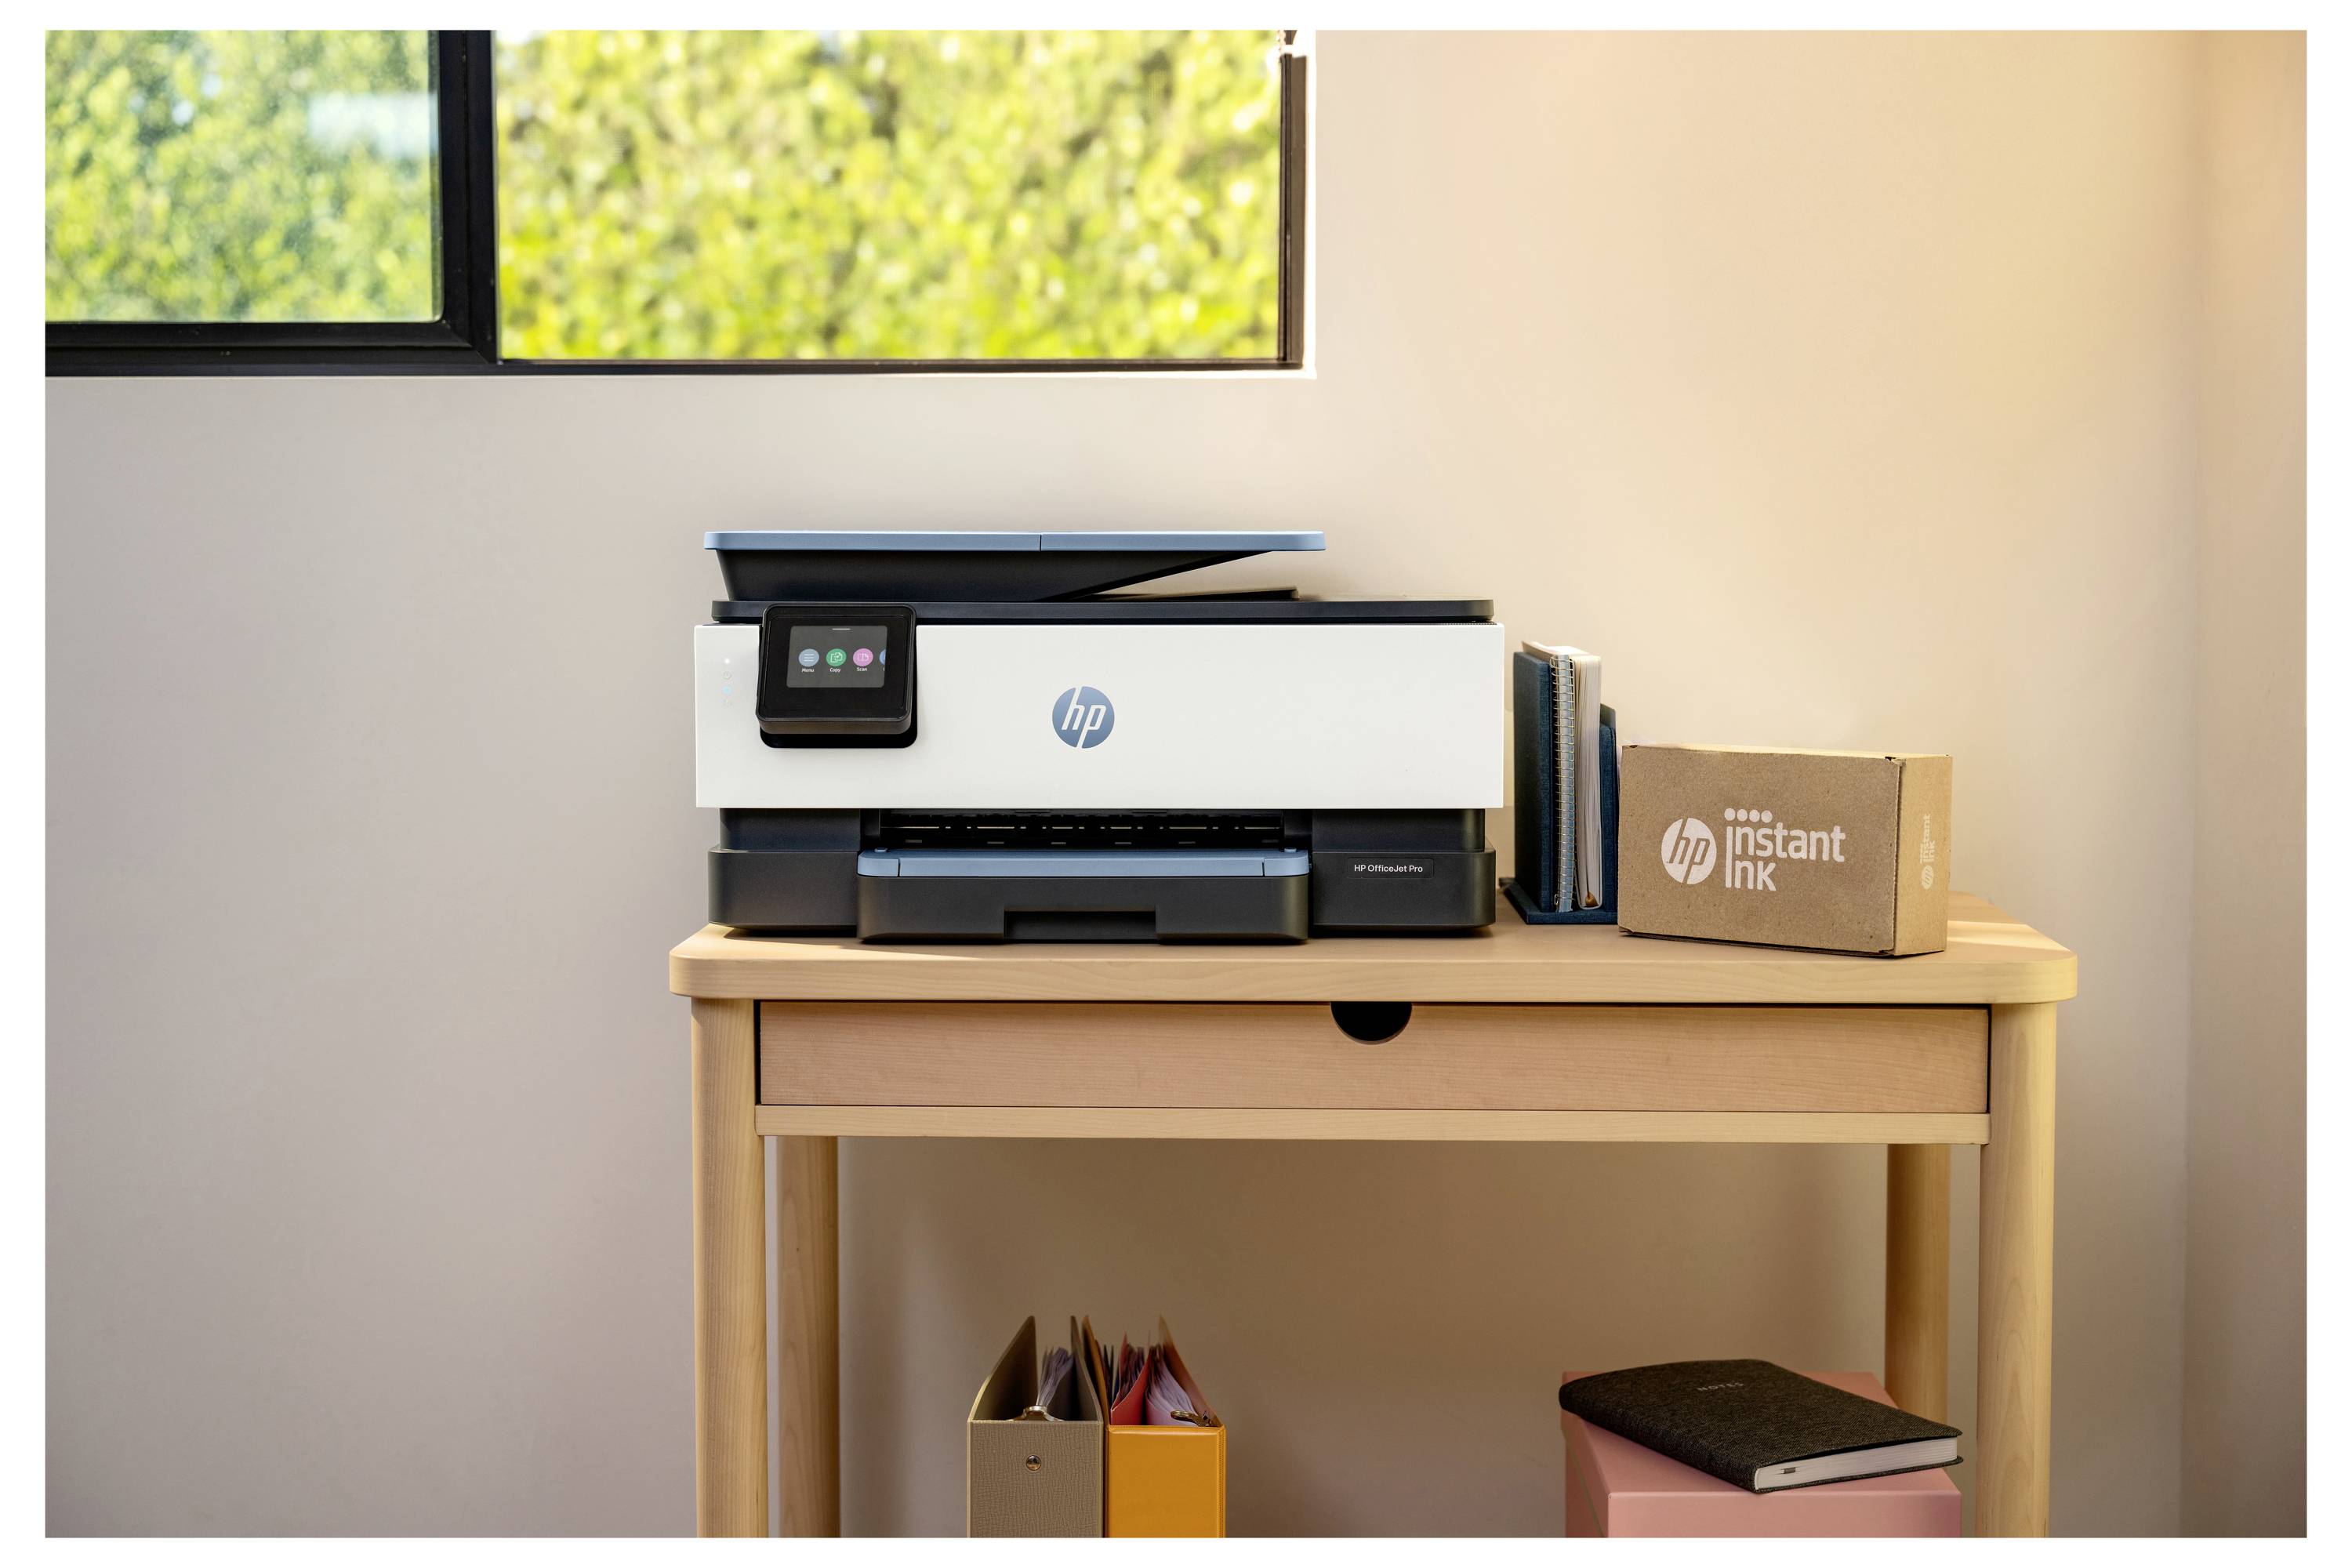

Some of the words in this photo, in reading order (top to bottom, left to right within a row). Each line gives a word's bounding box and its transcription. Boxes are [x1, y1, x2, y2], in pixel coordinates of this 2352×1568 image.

[1058, 686, 1109, 749] hp
[1666, 818, 1712, 884] hp
[1726, 820, 1846, 862] instant
[1367, 864, 1407, 873] OfficeJet
